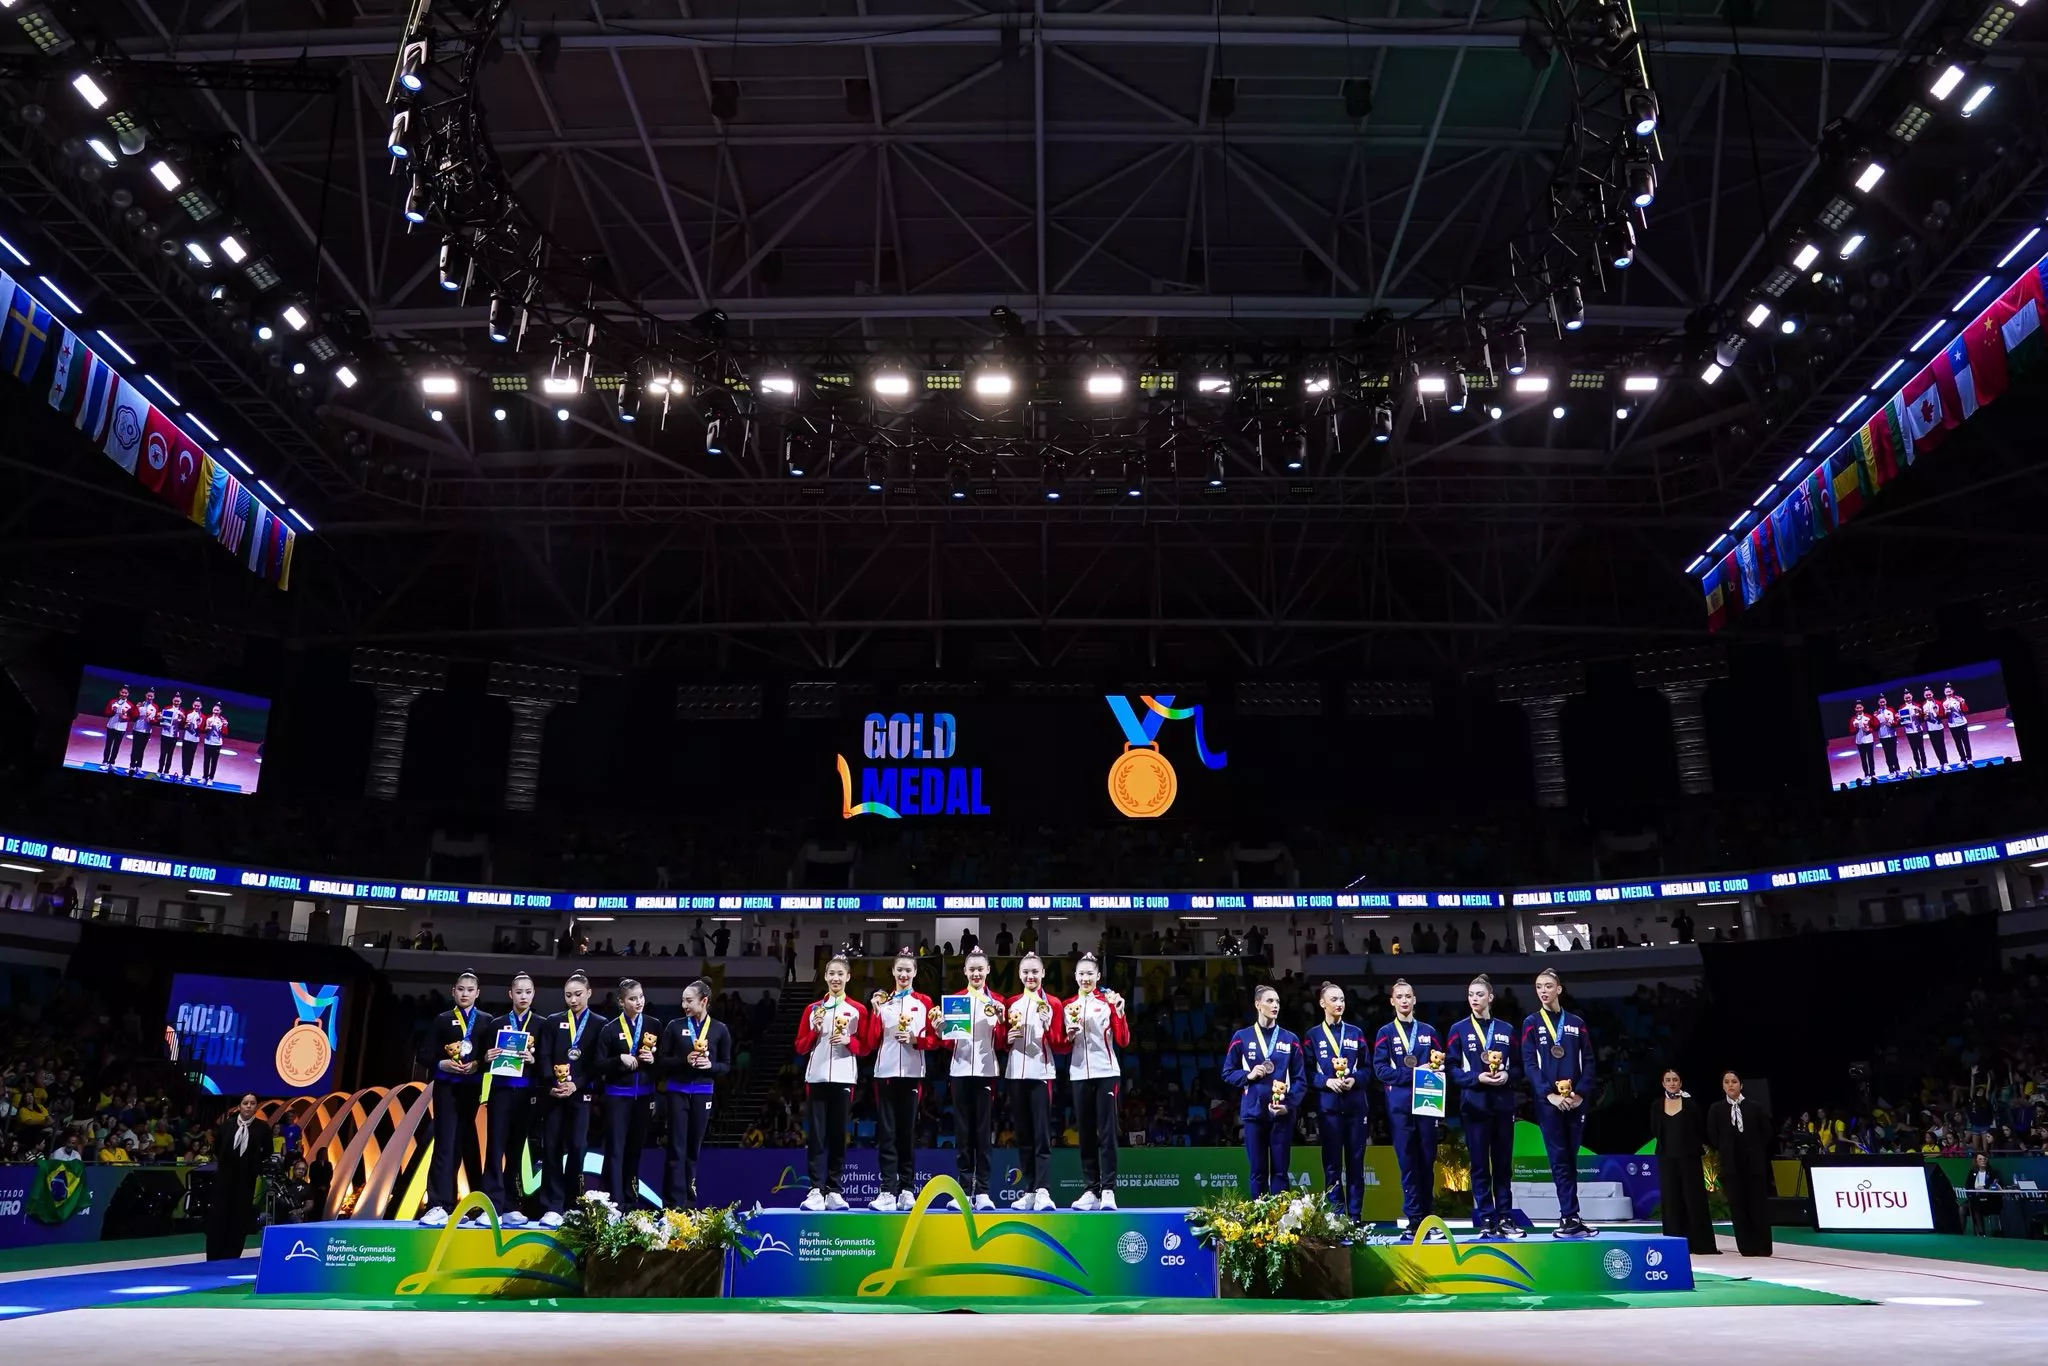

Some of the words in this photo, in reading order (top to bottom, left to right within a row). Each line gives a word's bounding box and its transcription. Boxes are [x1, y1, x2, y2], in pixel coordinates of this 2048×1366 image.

[863, 712, 956, 759] GOLD
[862, 767, 990, 815] MEDAL
[6, 838, 20, 852] DE
[21, 841, 47, 857] OURO
[52, 847, 77, 863] GOLD
[78, 852, 111, 868] MEDAL
[1935, 851, 1963, 866] GOLD
[1964, 846, 1999, 862] MEDAL
[120, 858, 171, 876] MEDALHA
[174, 864, 187, 877] DE
[189, 866, 216, 880] OURO
[1838, 861, 1886, 878] MEDALHA
[1887, 860, 1901, 872] DE
[1903, 856, 1930, 870] OURO
[241, 872, 267, 886] GOLD
[269, 876, 300, 890] MEDAL
[1772, 873, 1796, 886] GOLD
[1798, 869, 1831, 883] MEDAL
[309, 880, 354, 896] MEDALHA
[356, 885, 369, 896] DE
[371, 886, 396, 898] OURO
[1596, 888, 1620, 900] GOLD
[1621, 886, 1654, 898] MEDAL
[1661, 882, 1707, 896] MEDALHA
[1708, 881, 1721, 892] DE
[1723, 879, 1748, 891] OURO
[401, 887, 426, 900] GOLD
[427, 889, 459, 902] MEDAL
[467, 892, 511, 905] MEDALHA
[514, 894, 525, 905] DE
[527, 895, 551, 907] OURO
[1398, 895, 1428, 906] MEDAL
[1438, 895, 1460, 906] GOLD
[1462, 895, 1492, 906] MEDAL
[1554, 892, 1565, 903] DE
[1567, 890, 1591, 902] OURO
[574, 897, 597, 908] GOLD
[599, 897, 628, 908] MEDAL
[635, 897, 677, 908] MEDALHA
[679, 897, 690, 908] DE
[692, 897, 715, 908] OURO
[719, 897, 742, 909] GOLD
[744, 897, 773, 908] MEDAL
[781, 897, 822, 909] MEDALHA
[824, 898, 835, 908] DE
[837, 898, 860, 909] OURO
[883, 897, 905, 909] GOLD
[907, 897, 936, 908] MEDAL
[944, 897, 986, 908] MEDALHA
[988, 897, 998, 908] DE
[1001, 897, 1023, 908] OURO
[1028, 897, 1050, 908] GOLD
[1053, 897, 1082, 908] MEDAL
[1090, 897, 1131, 908] MEDALHA
[1133, 897, 1144, 908] DE
[1146, 897, 1169, 908] OURO
[1192, 896, 1214, 908] GOLD
[1216, 897, 1246, 907] MEDAL
[1253, 896, 1295, 907] MEDALHA
[1297, 896, 1308, 907] DE
[1310, 896, 1332, 906] OURO
[1337, 895, 1359, 907] GOLD
[1361, 895, 1391, 906] MEDAL
[176, 1004, 234, 1034] GOLD
[183, 1035, 246, 1067] EDAL
[841, 1171, 876, 1183] ythmic
[1143, 1179, 1179, 1187] JANEIRO
[841, 1184, 859, 1194] orld
[1835, 1190, 1908, 1214] FUJITSU
[799, 1238, 832, 1247] Rhythmic
[834, 1238, 875, 1247] Gymnastics
[327, 1245, 358, 1254] Rhythmic
[359, 1245, 396, 1254] Gymnastics
[799, 1248, 820, 1256] World
[821, 1248, 876, 1257] Championships
[326, 1254, 345, 1262] World
[346, 1254, 396, 1263] Championships
[1161, 1255, 1185, 1266] CBG
[1645, 1270, 1669, 1281] CBG
